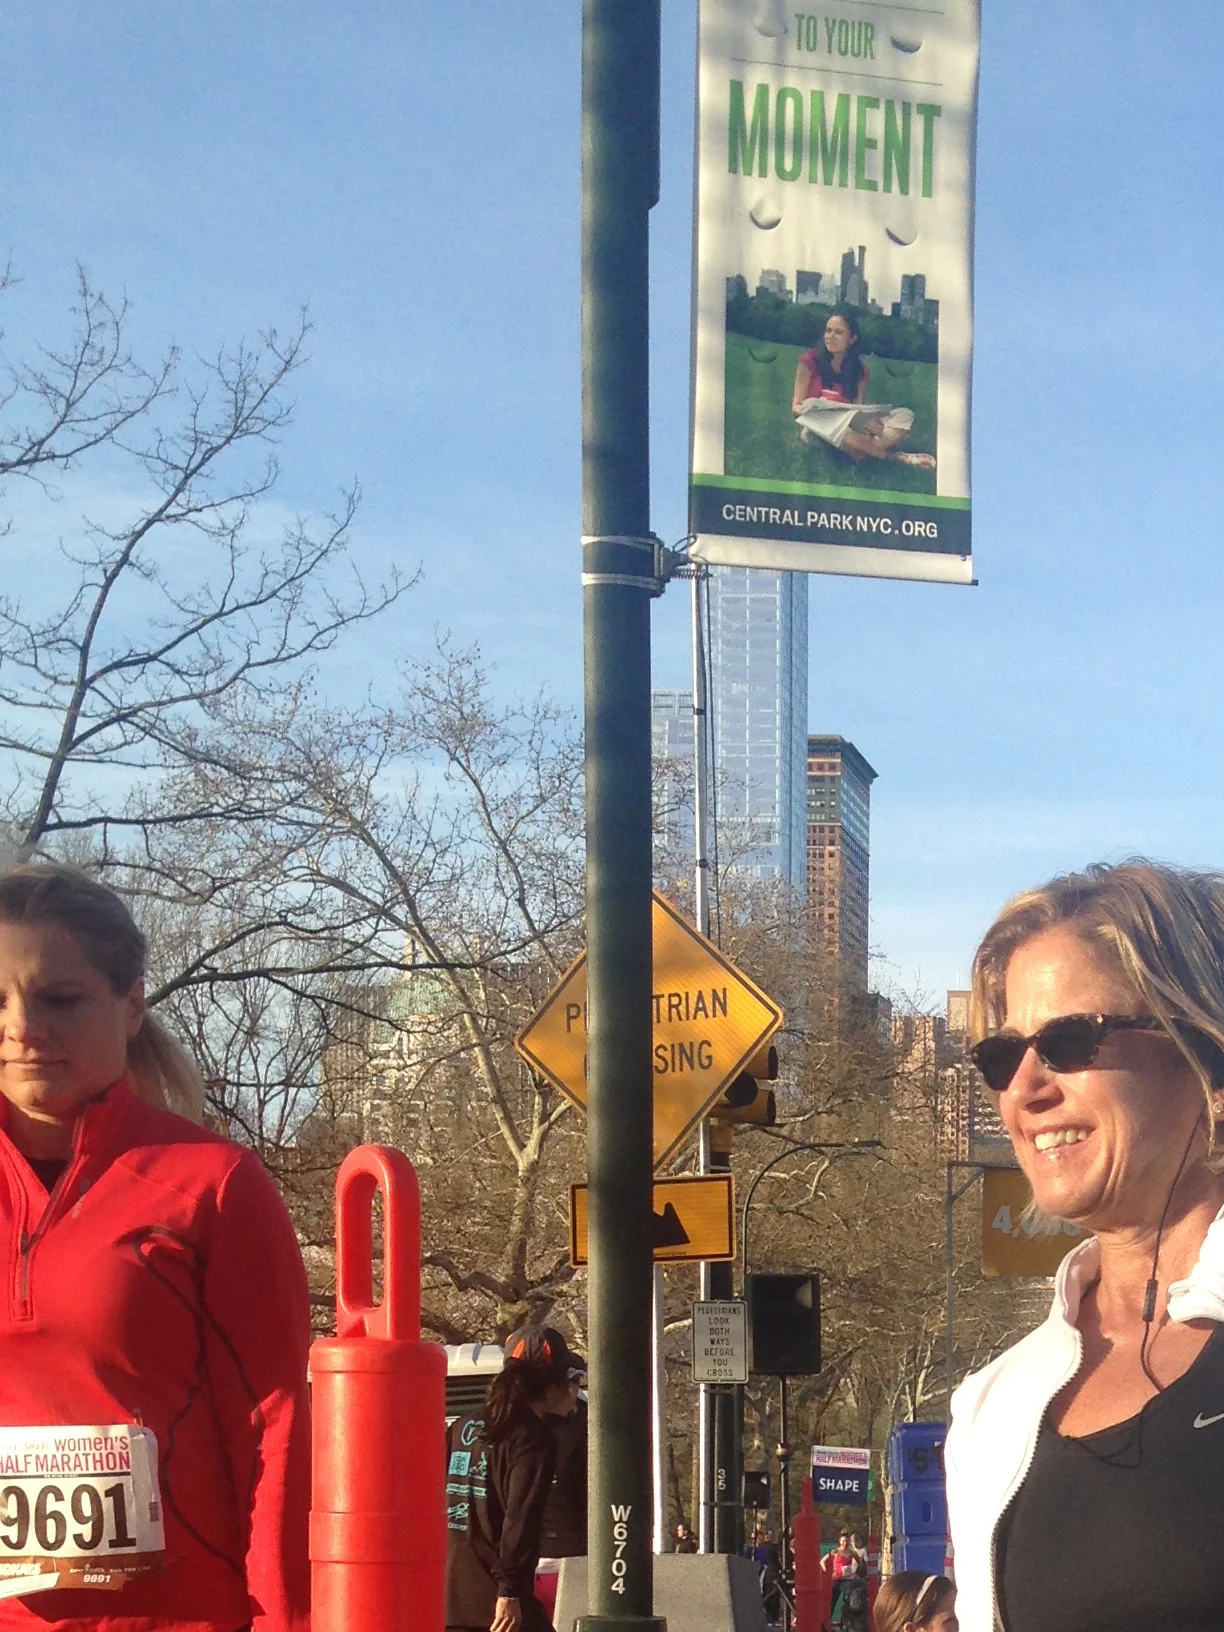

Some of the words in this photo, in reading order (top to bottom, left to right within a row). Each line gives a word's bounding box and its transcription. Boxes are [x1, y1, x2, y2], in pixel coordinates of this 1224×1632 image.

[794, 13, 817, 52] TO
[824, 18, 876, 60] YOUR
[727, 78, 944, 199] MOMENT
[697, 1306, 742, 1315] PEDESTRIANS
[708, 1317, 730, 1325] LOOK
[709, 1327, 730, 1336] BOTH
[709, 1337, 730, 1346] WAYS
[704, 1347, 735, 1357] BEFORE
[712, 1358, 728, 1367] YOU
[706, 1368, 733, 1377] CROSS
[54, 1435, 129, 1452] women's
[35, 1450, 131, 1473] MARATHON
[818, 1477, 860, 1493] SHAPE
[0, 1483, 137, 1551] 9691
[610, 1504, 633, 1595] W6704
